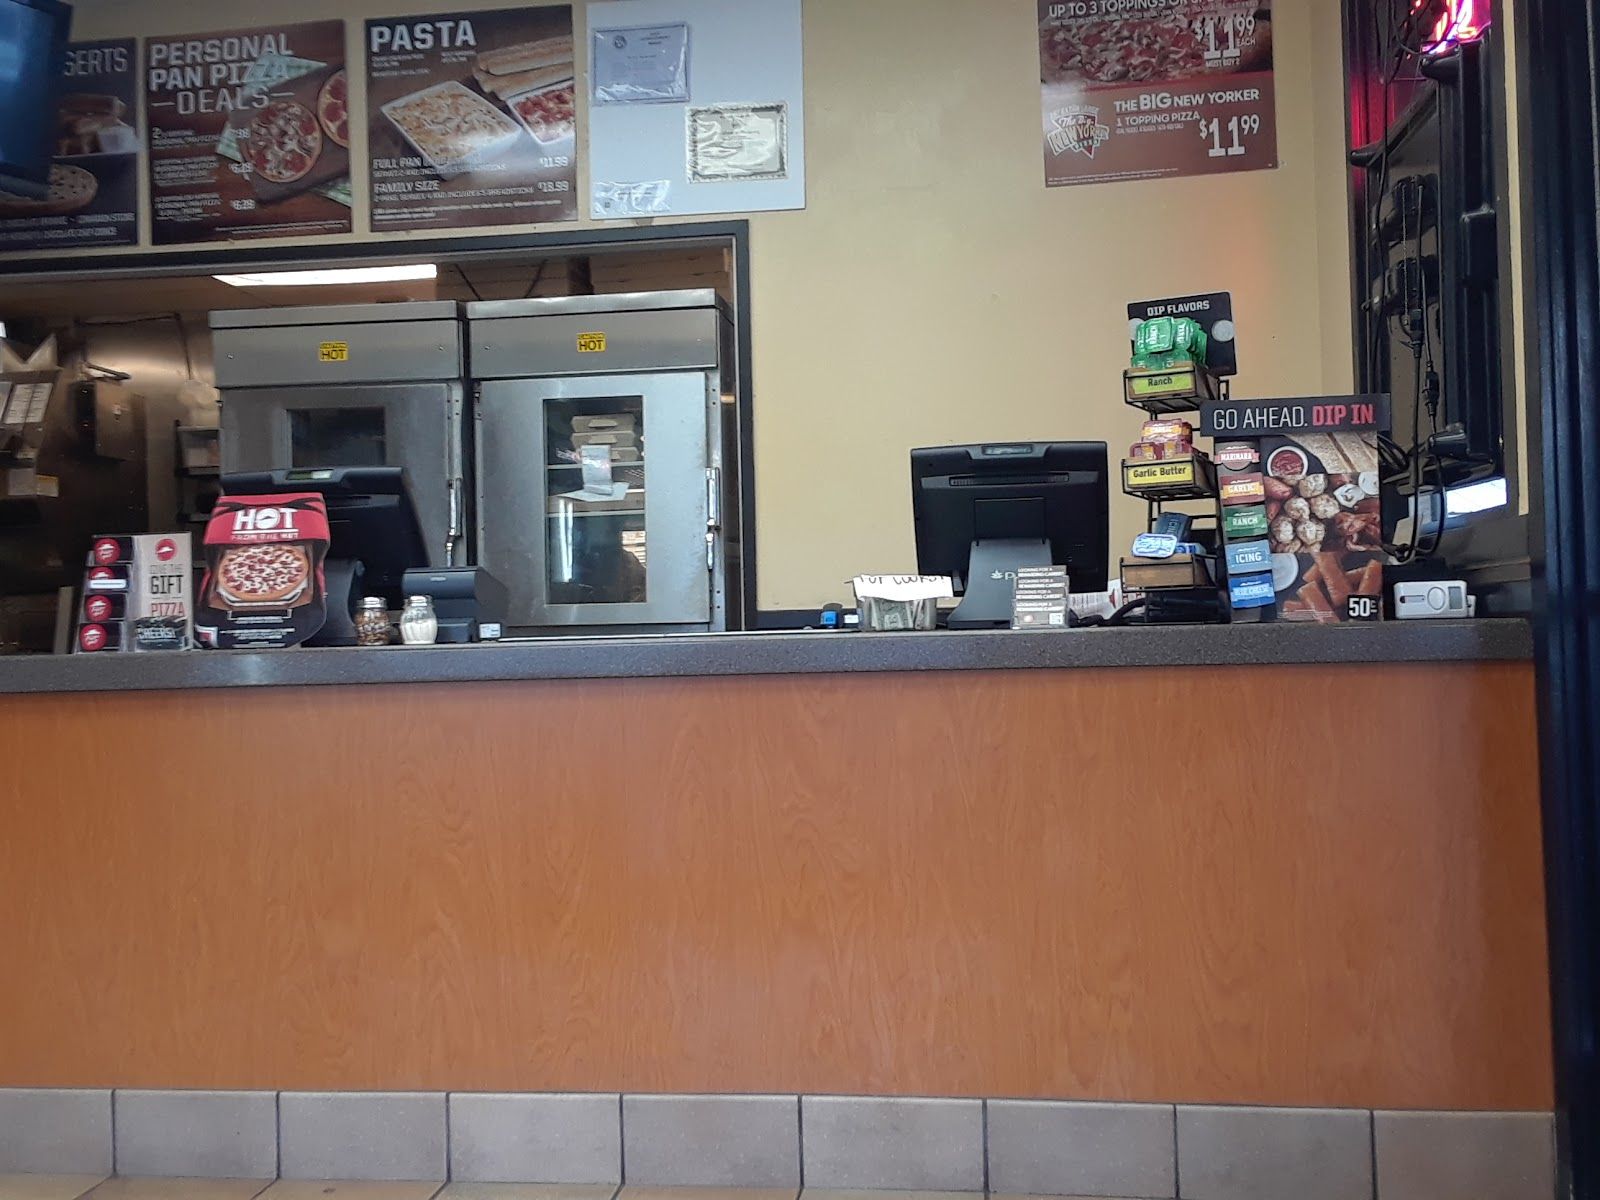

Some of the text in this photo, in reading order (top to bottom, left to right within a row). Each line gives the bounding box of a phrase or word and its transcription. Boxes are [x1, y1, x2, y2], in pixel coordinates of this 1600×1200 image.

[1049, 5, 1065, 17] UP
[1069, 3, 1087, 15] TO
[1090, 1, 1098, 13] 3
[370, 20, 477, 52] PASTA
[1237, 38, 1256, 47] EACH
[151, 33, 293, 66] PERSONAL
[150, 59, 289, 92] PAN PIZZA
[176, 85, 270, 115] DEALS
[1114, 100, 1138, 113] THE
[1139, 92, 1172, 110] BIG
[1173, 94, 1205, 107] NEW
[1207, 88, 1260, 104] YORKER
[1125, 113, 1170, 126] TOPPING
[1171, 111, 1201, 121] PIZZA
[414, 180, 440, 192] SIZE
[1147, 300, 1210, 316] DIP FLAVORS
[579, 339, 604, 351] HOT
[321, 349, 346, 360] HOT
[1148, 377, 1173, 387] Ranch
[1213, 409, 1238, 430] GO
[1243, 406, 1308, 429] AHEAD.
[1312, 405, 1347, 427] DIP
[1133, 466, 1186, 478] Garlic Butter
[232, 507, 298, 531] HOT
[1232, 516, 1258, 526] RANCH
[1235, 551, 1262, 564] ICING
[151, 575, 184, 594] GIFT
[151, 602, 185, 617] PIZZA
